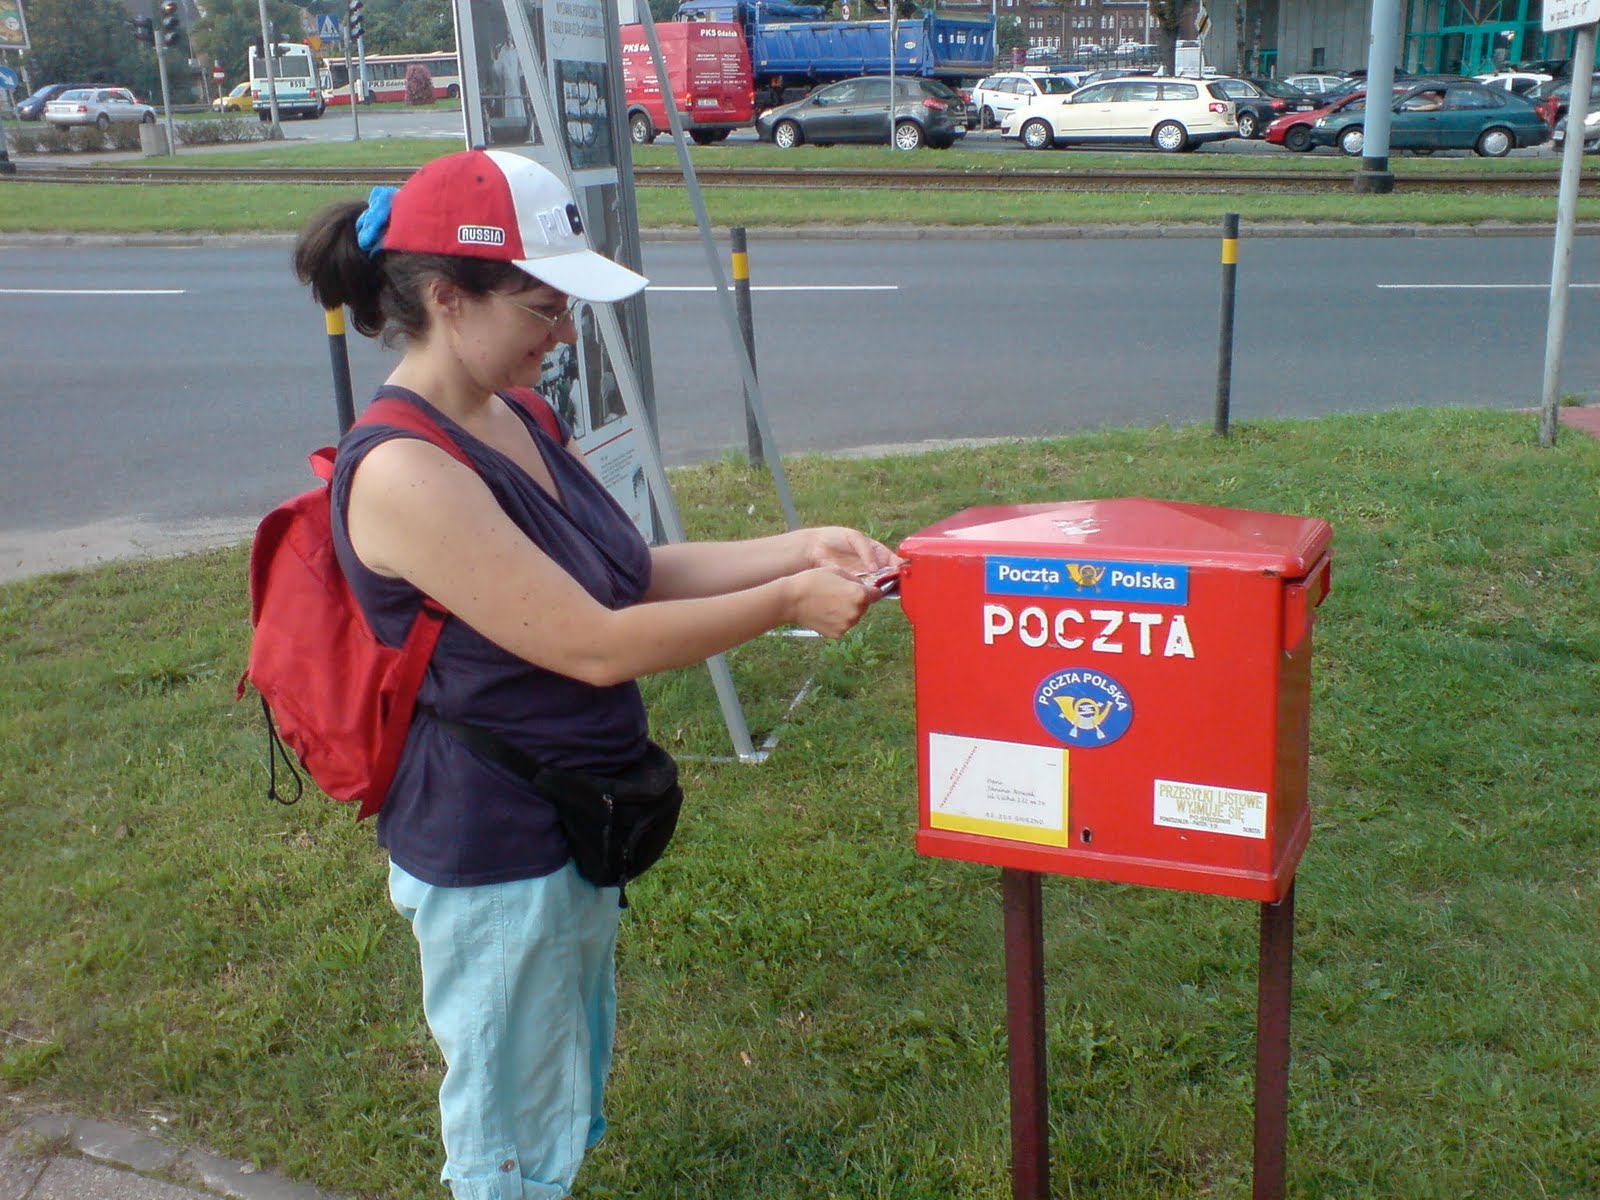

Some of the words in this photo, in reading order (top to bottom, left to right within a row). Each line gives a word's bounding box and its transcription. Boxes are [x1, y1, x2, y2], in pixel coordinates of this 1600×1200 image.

[700, 29, 716, 37] PKS
[623, 44, 639, 53] PKS
[368, 80, 384, 88] PKS
[462, 228, 501, 243] RUSSIA
[998, 565, 1060, 584] Poczta
[1111, 571, 1176, 590] Polska
[984, 604, 1196, 659] POCZTA
[1038, 672, 1081, 706] POCZTA
[1083, 673, 1128, 712] POLSKA
[1176, 799, 1224, 818] WYJMUJE
[1218, 791, 1263, 810] LISTOWE
